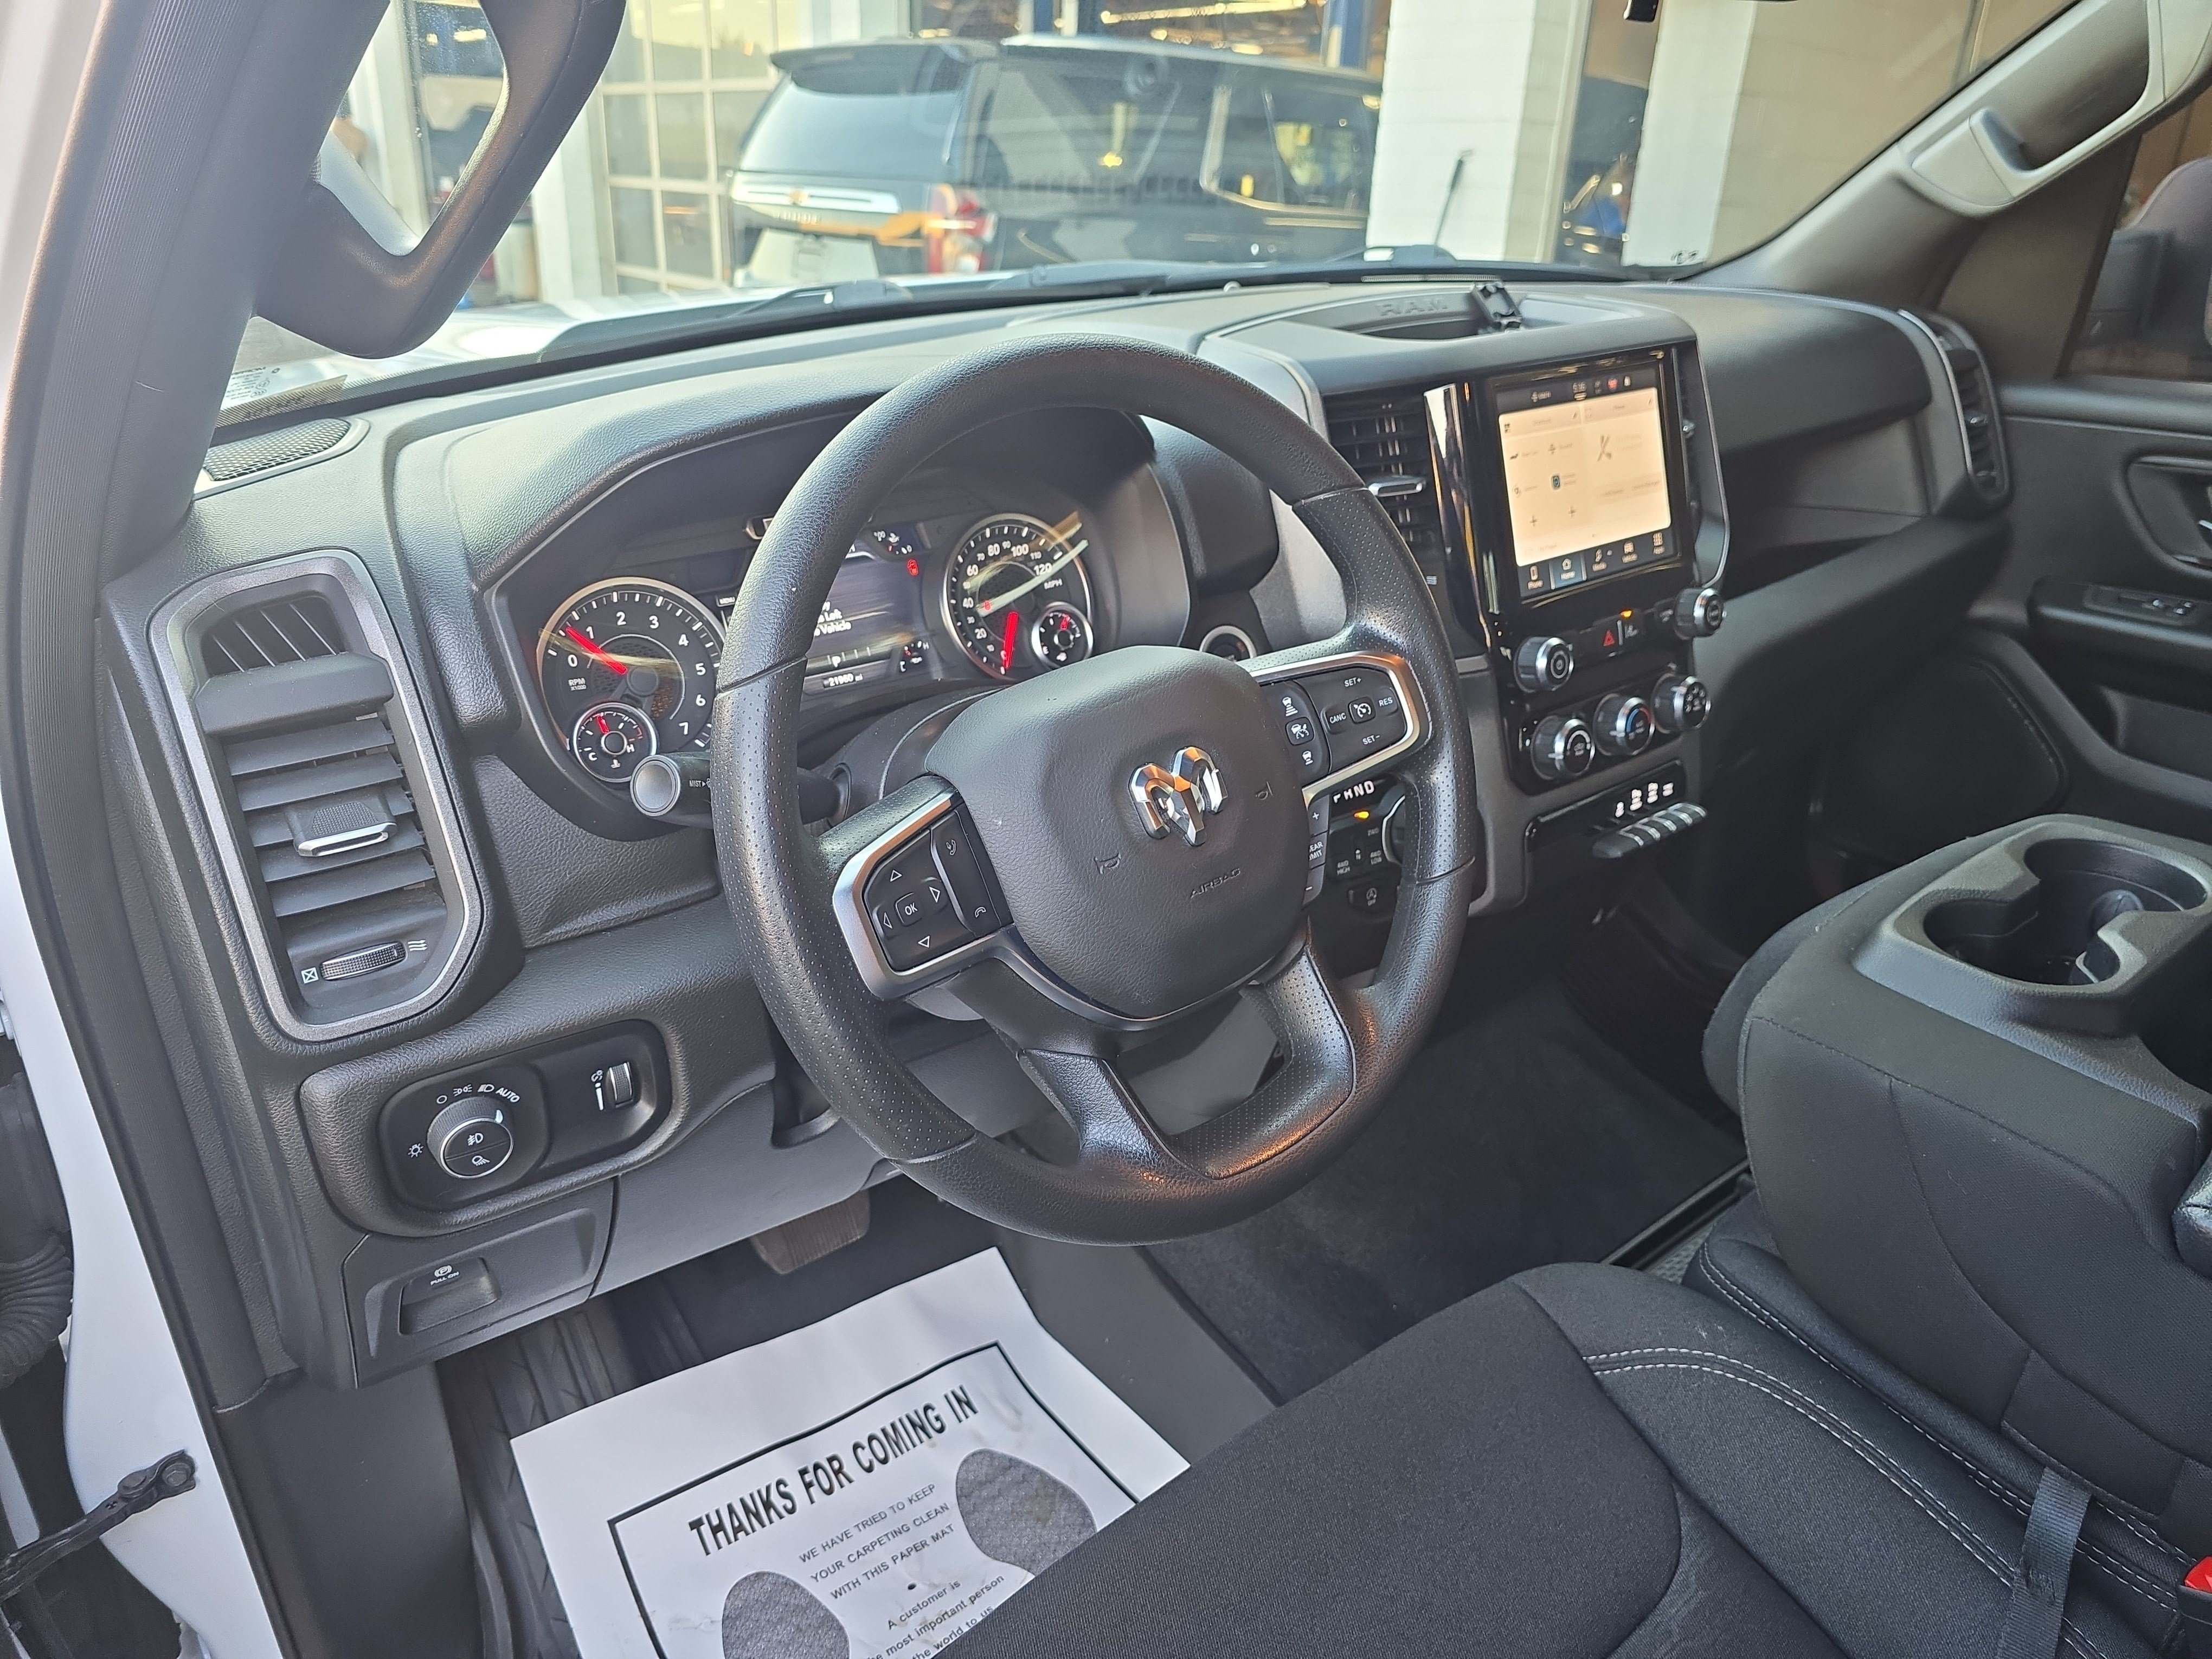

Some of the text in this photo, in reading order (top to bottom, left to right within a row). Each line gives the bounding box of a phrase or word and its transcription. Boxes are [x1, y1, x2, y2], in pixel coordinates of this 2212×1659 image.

[988, 543, 1000, 556] 80
[1011, 544, 1029, 557] 100
[967, 564, 979, 576] 60
[1034, 563, 1052, 575] 120
[963, 597, 974, 608] 40
[616, 612, 626, 625] 2
[825, 609, 843, 621] Left
[650, 616, 659, 629] 3
[820, 620, 851, 634] Vehicle
[586, 626, 595, 639] 1
[975, 628, 987, 639] 20
[678, 634, 689, 647] 4
[568, 654, 578, 667] 0
[832, 655, 841, 667] P
[696, 663, 705, 676] 5
[568, 678, 586, 686] RPM
[1344, 677, 1361, 687] SET+
[696, 695, 705, 706] 6
[1379, 697, 1393, 707] RES
[1329, 712, 1347, 724] CANC
[679, 722, 689, 735] 7
[1362, 734, 1380, 745] SET-
[626, 744, 635, 753] H
[588, 751, 597, 761] C
[1309, 849, 1323, 861] IMIT
[904, 902, 918, 916] OK
[496, 1087, 520, 1104] AUTO
[430, 1271, 460, 1286] PULL ON
[688, 1384, 979, 1556] THANKS FOR COMING IN
[799, 1483, 936, 1563] WE HAVE TRIED TO KEEP
[811, 1502, 950, 1583] YOUR CARPETING CLEAN
[830, 1523, 955, 1599] WITH THIS PAPER MAT
[888, 1580, 961, 1630] A customer is
[886, 1634, 915, 1656] most
[916, 1600, 968, 1637] important
[969, 1575, 1005, 1605] person
[933, 1628, 964, 1651] world
[966, 1617, 978, 1629] to
[980, 1605, 994, 1618] us
